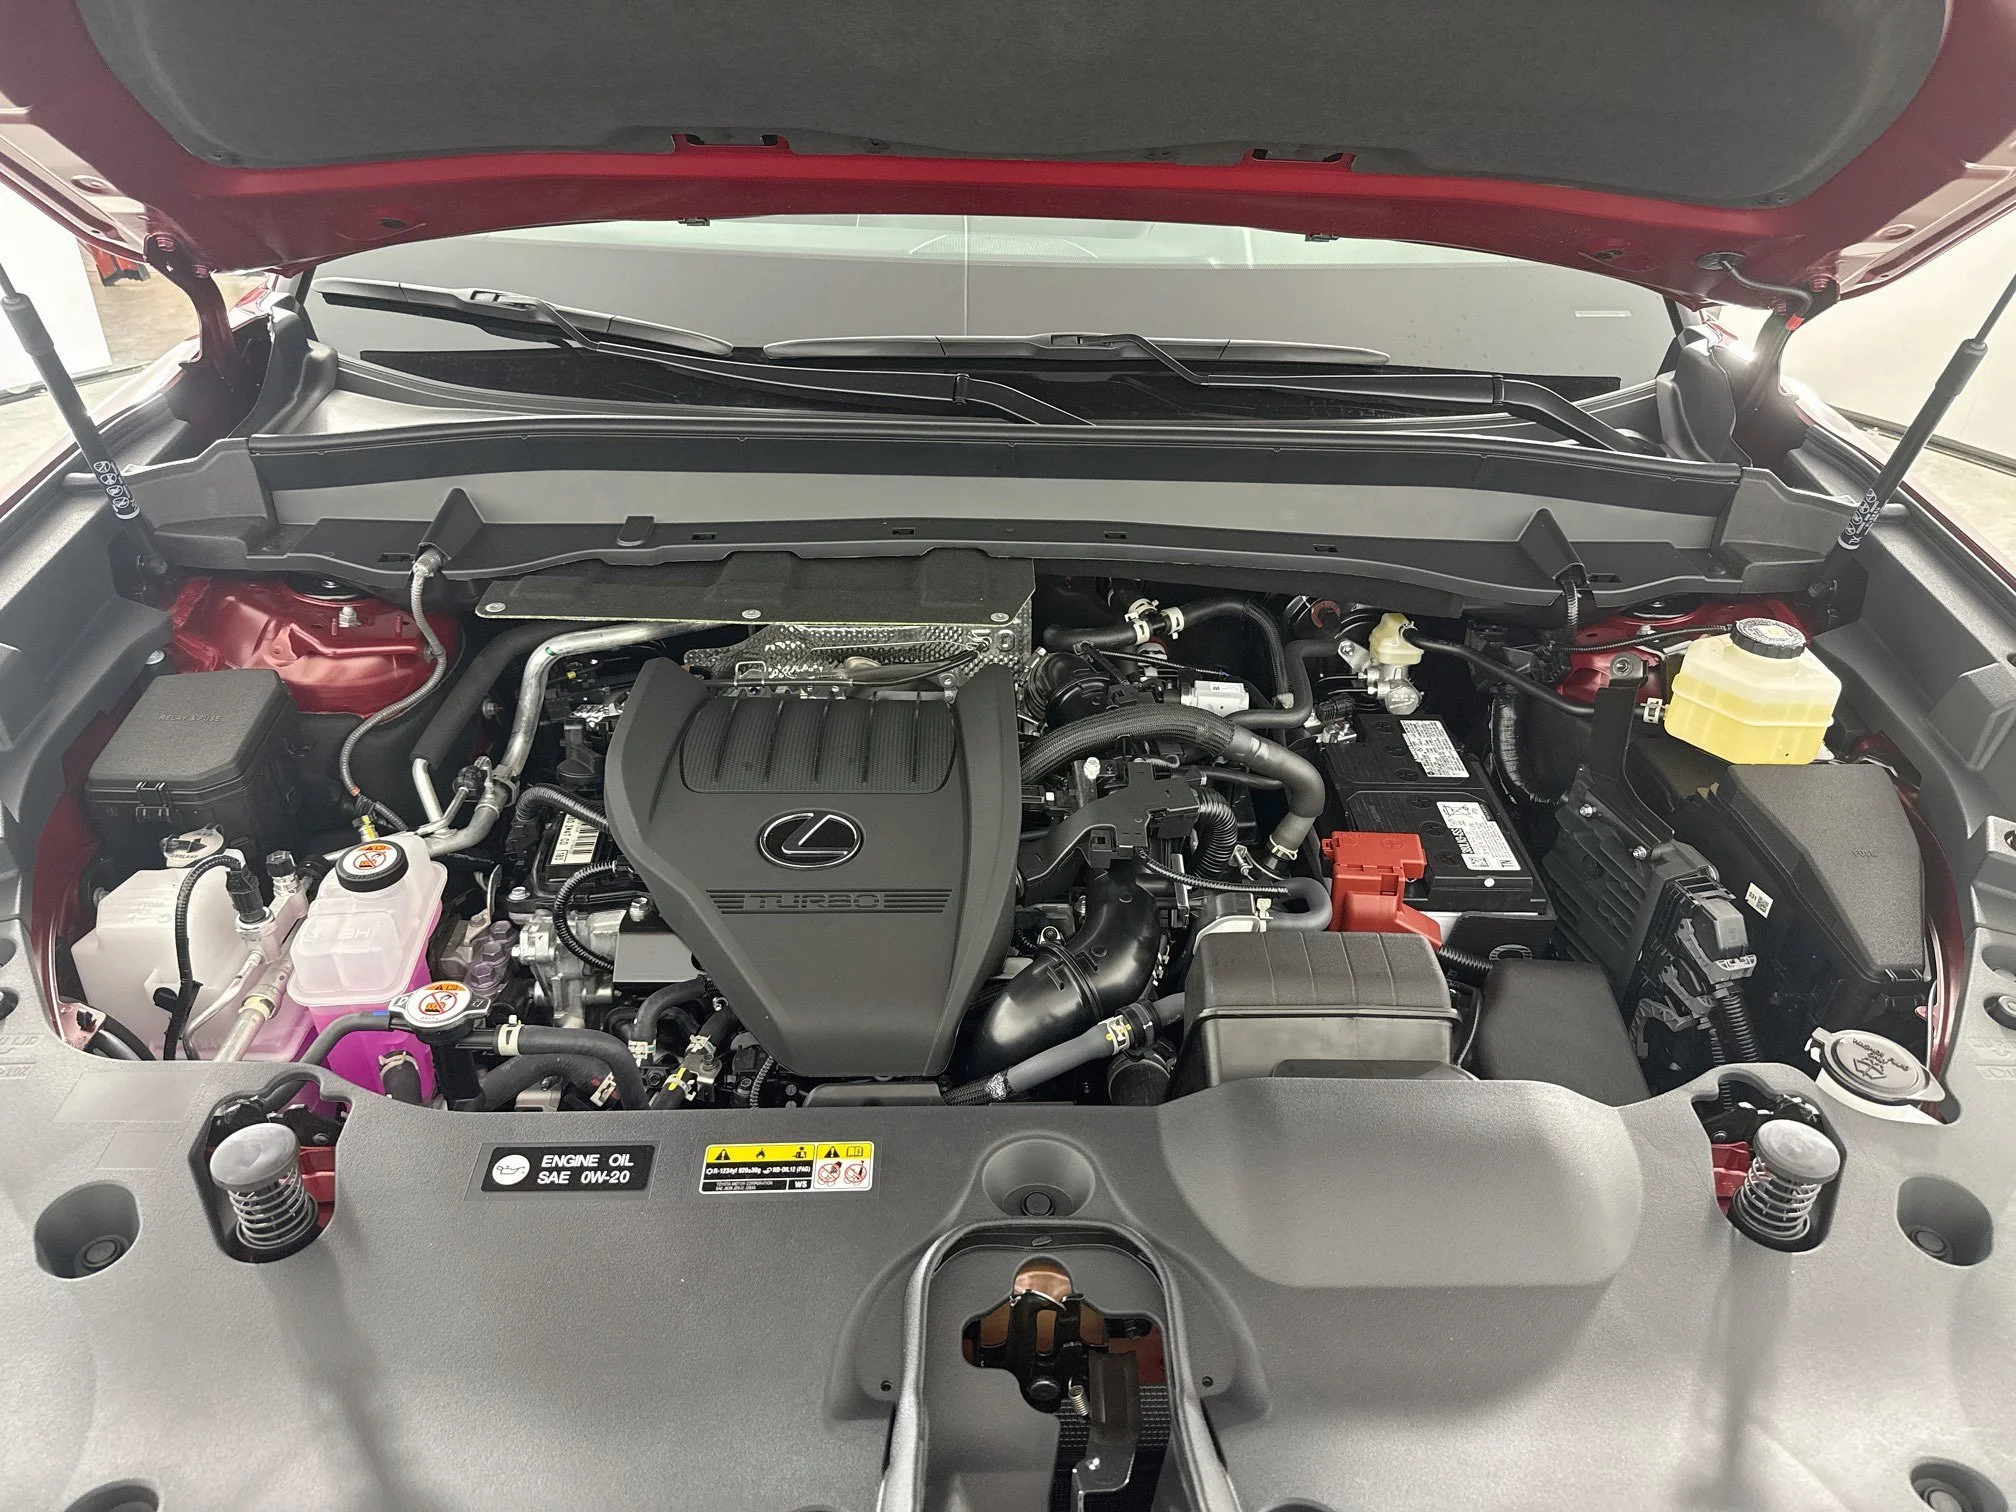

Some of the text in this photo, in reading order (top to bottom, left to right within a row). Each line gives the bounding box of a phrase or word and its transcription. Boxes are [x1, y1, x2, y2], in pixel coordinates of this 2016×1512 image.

[748, 893, 880, 909] TURBO
[1852, 1038, 1910, 1072] WASHER FLUID
[1867, 1052, 1889, 1065] ONLY
[541, 1153, 634, 1168] ENGINE OIL
[537, 1170, 630, 1184] SAE 0W-20
[796, 1166, 811, 1174] (PAG)
[794, 1180, 808, 1189] WS
